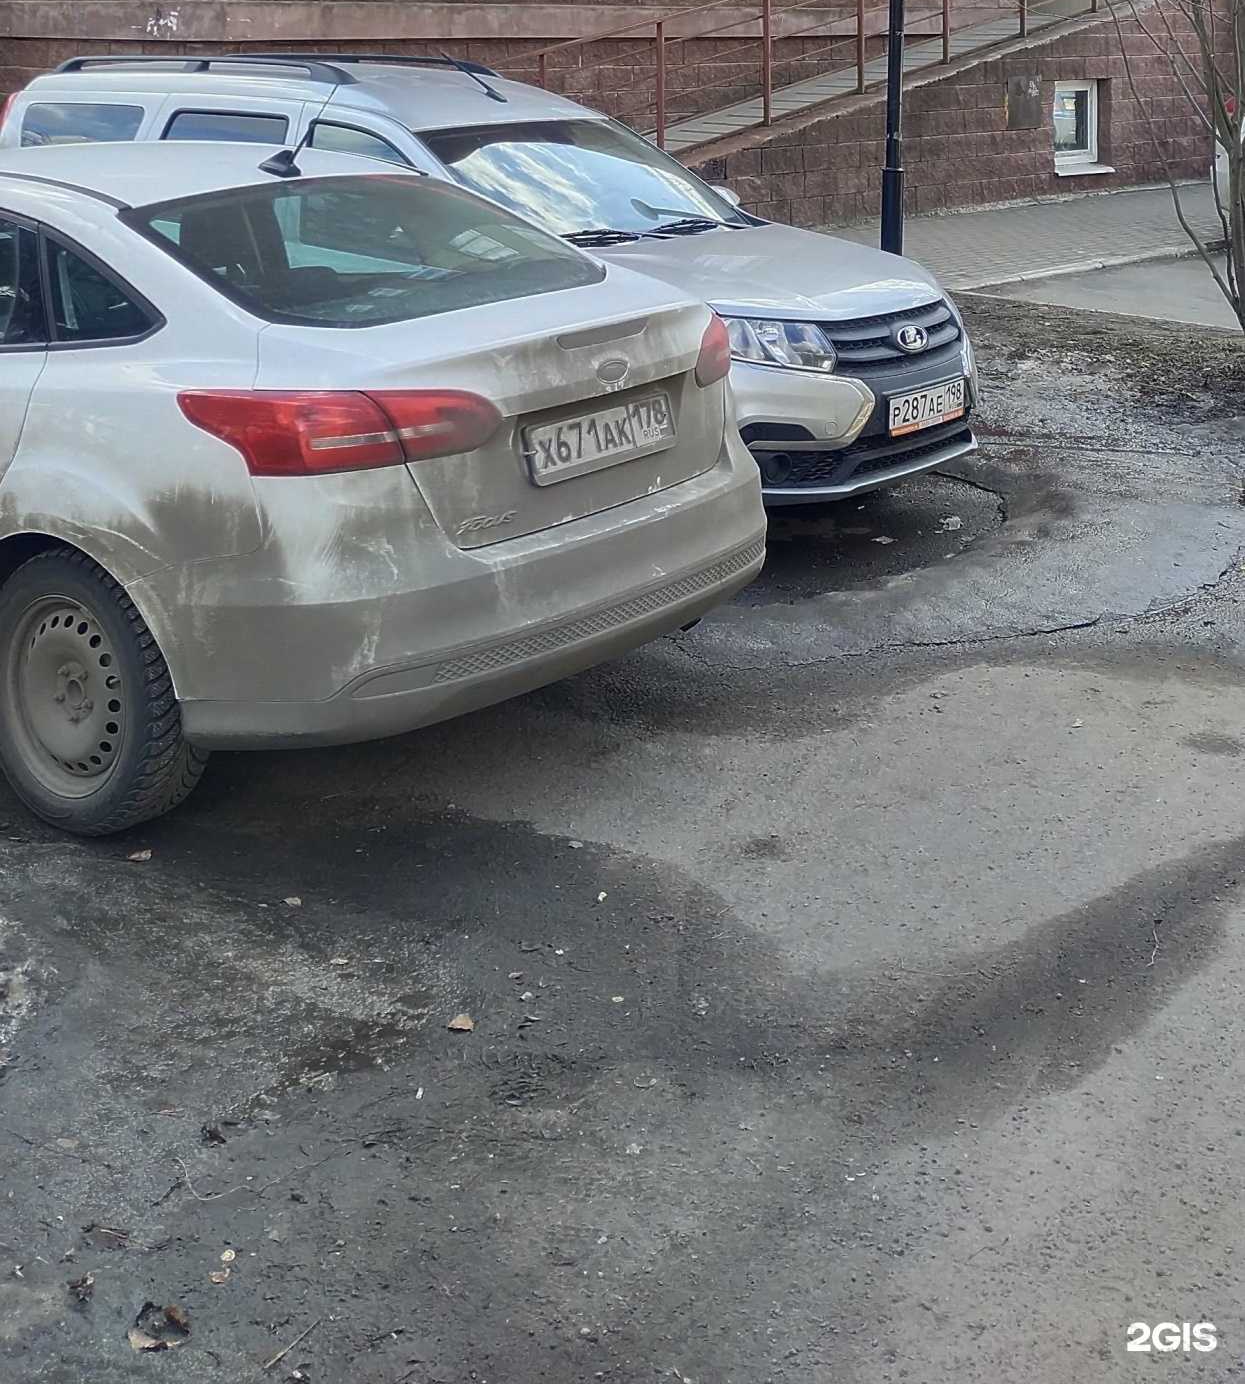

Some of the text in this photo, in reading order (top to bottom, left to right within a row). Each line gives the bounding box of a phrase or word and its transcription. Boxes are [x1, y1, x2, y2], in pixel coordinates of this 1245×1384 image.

[893, 394, 943, 426] Р287АЕ
[946, 382, 962, 407] 198
[539, 399, 667, 469] Х671АК 178
[643, 424, 661, 440] RUS
